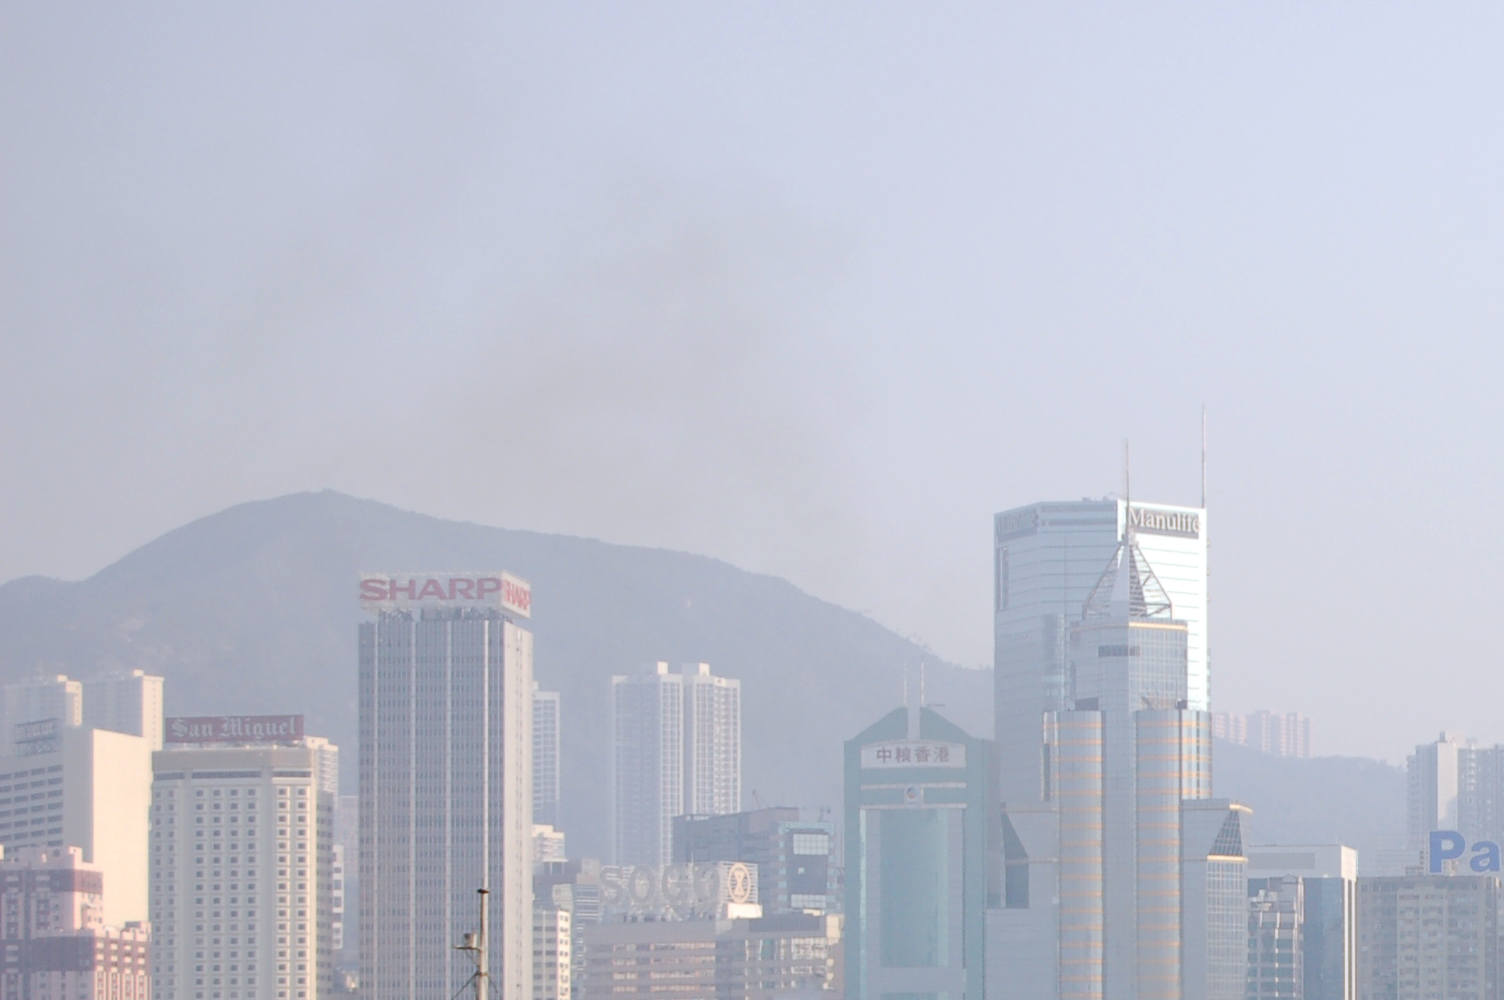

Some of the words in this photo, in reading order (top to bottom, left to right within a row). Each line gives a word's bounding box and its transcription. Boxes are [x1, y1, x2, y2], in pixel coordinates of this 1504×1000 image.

[1128, 507, 1201, 533] Manulife
[359, 577, 502, 601] SHARP
[502, 578, 531, 610] SHARP
[171, 718, 214, 738] San
[220, 715, 296, 739] Miguel
[600, 864, 720, 905] SOGO
